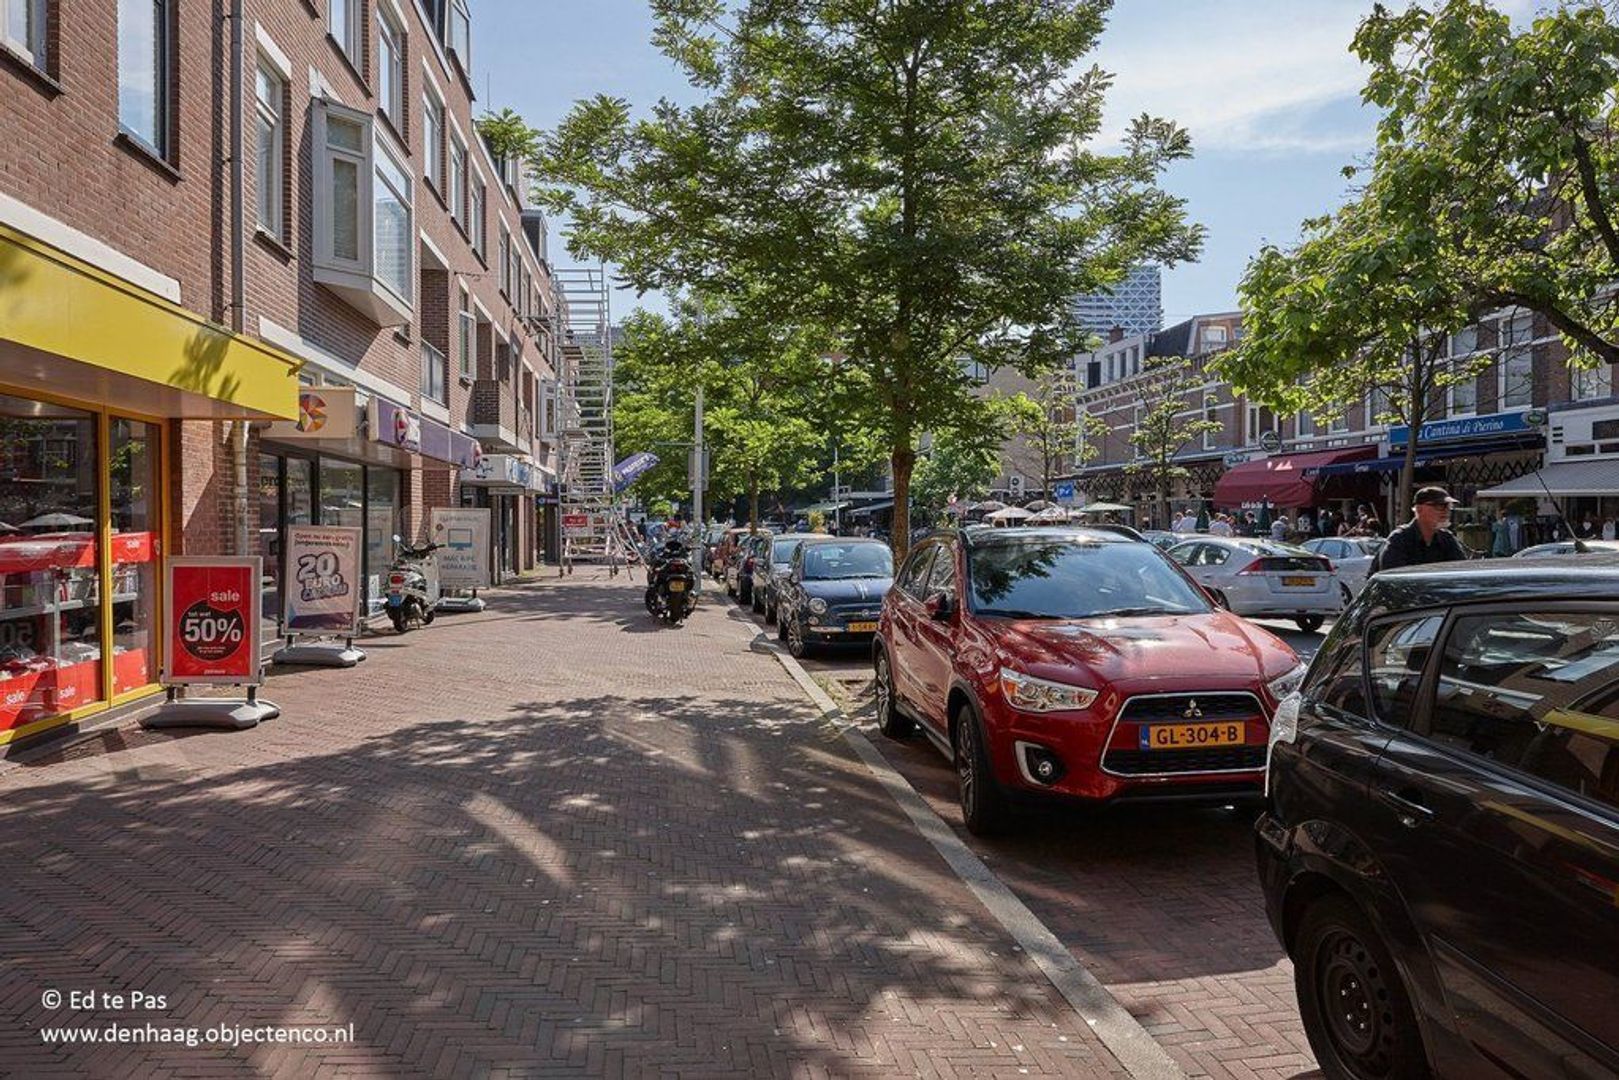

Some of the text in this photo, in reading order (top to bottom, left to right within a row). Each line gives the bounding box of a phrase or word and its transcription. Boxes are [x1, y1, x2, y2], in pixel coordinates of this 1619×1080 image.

[1424, 425, 1461, 440] Cantina
[298, 553, 337, 580] 20
[211, 590, 240, 602] sale
[184, 618, 242, 643] 50%
[6, 690, 26, 704] sale
[59, 685, 76, 699] sale
[1157, 726, 1238, 745] GL-304-B
